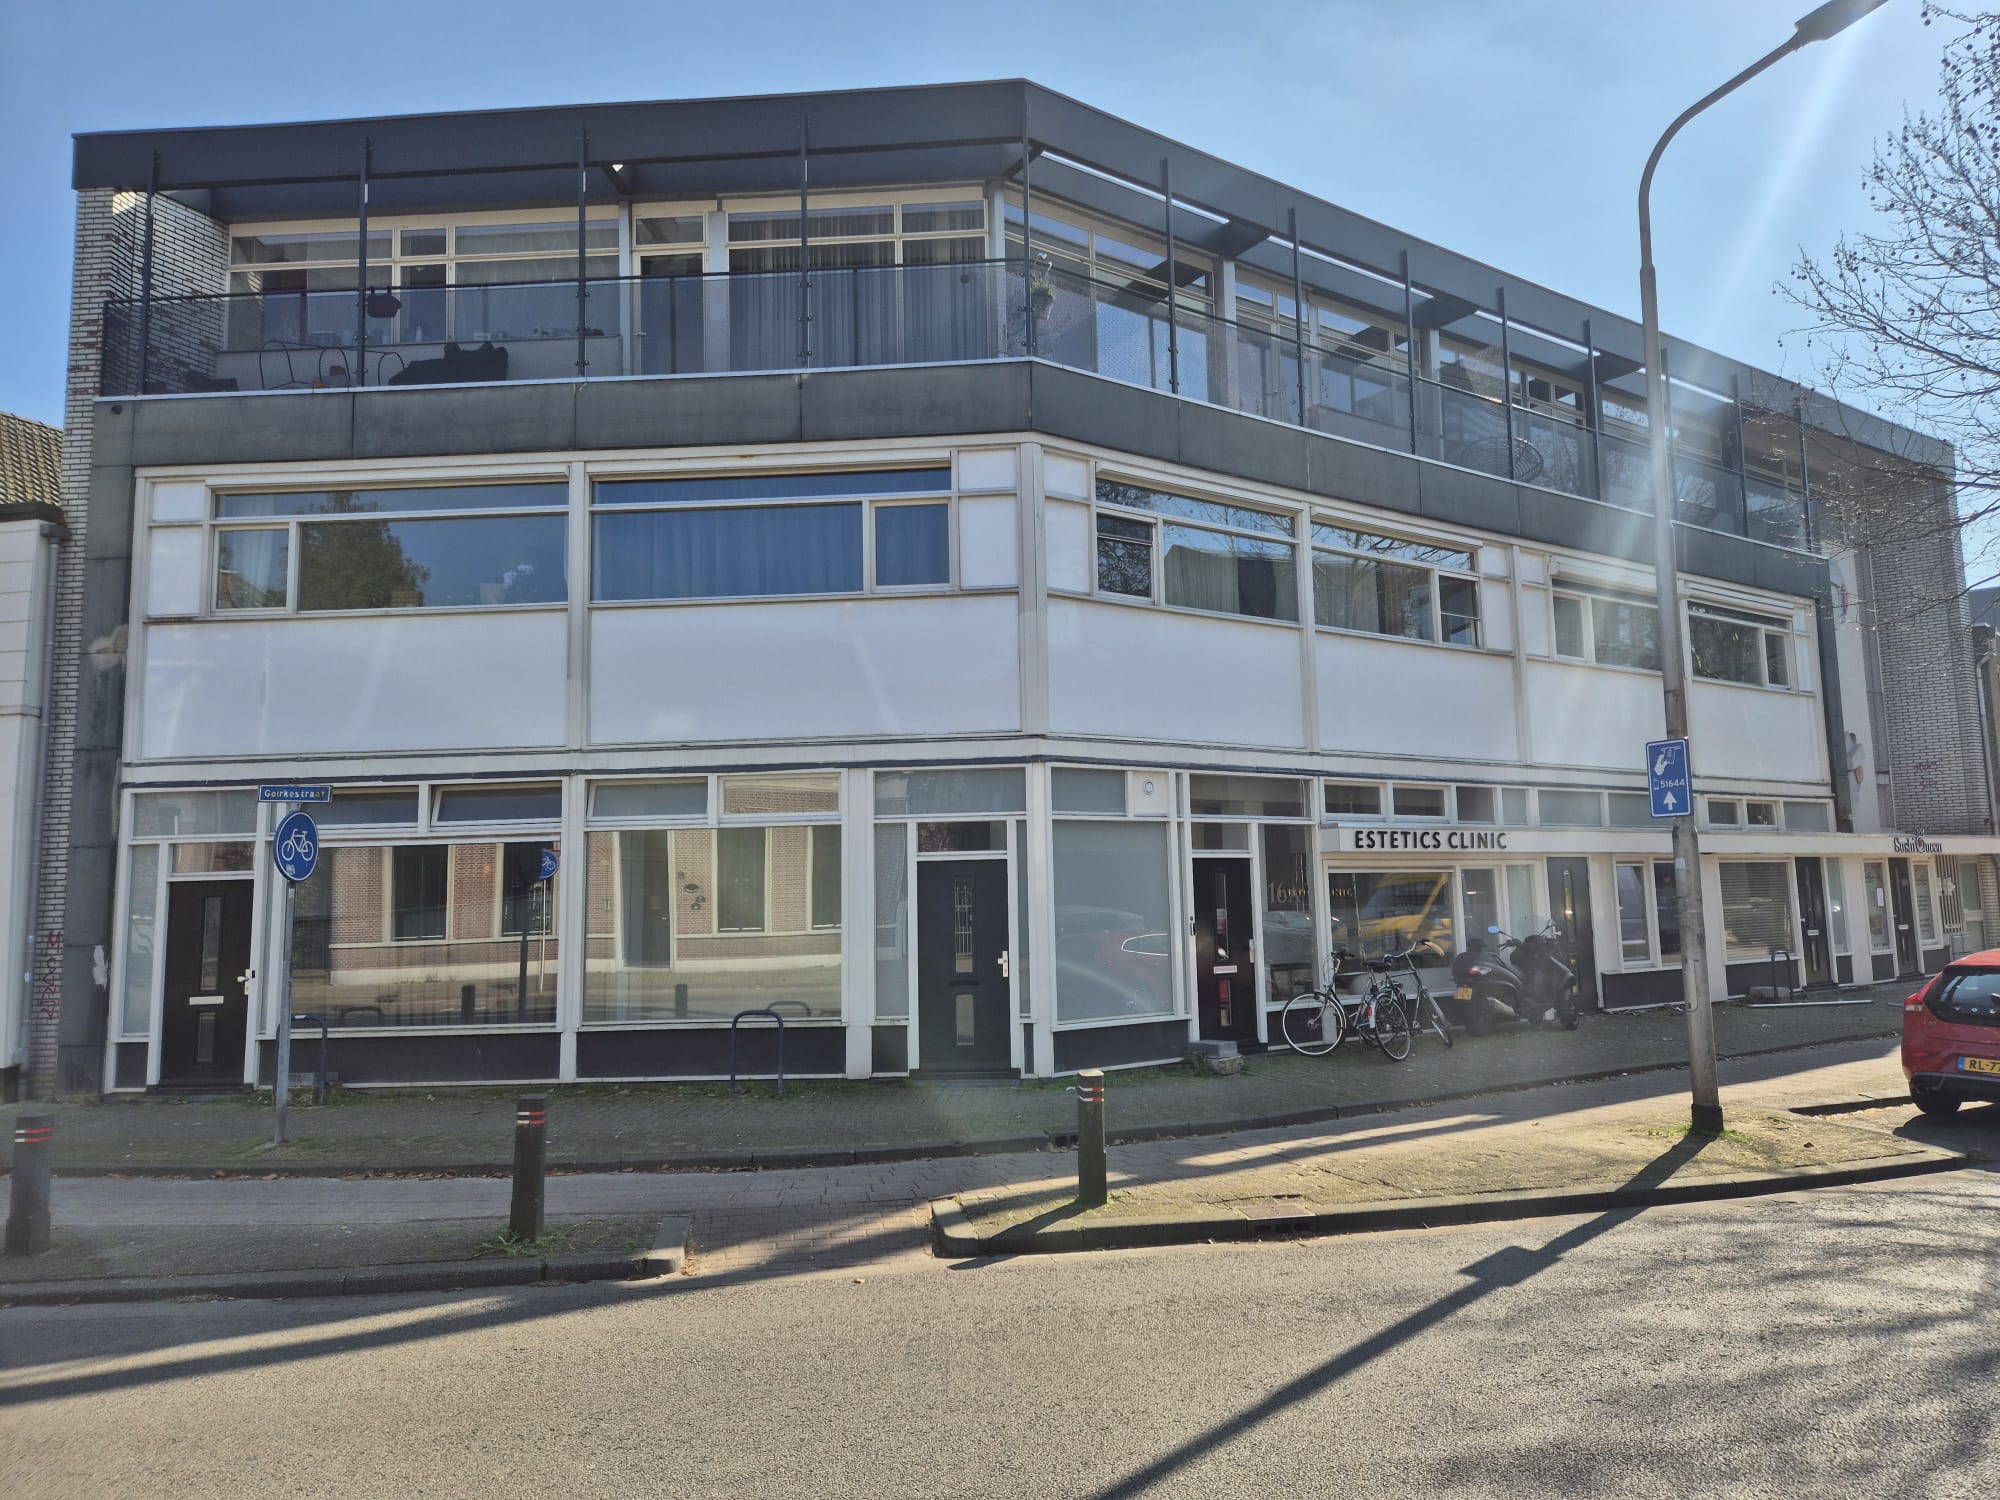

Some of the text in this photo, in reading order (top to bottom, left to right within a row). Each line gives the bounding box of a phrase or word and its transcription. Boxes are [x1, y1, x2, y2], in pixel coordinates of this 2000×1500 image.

[1660, 779, 1685, 789] 51644
[1355, 830, 1507, 849] ESTETICS CLINIC
